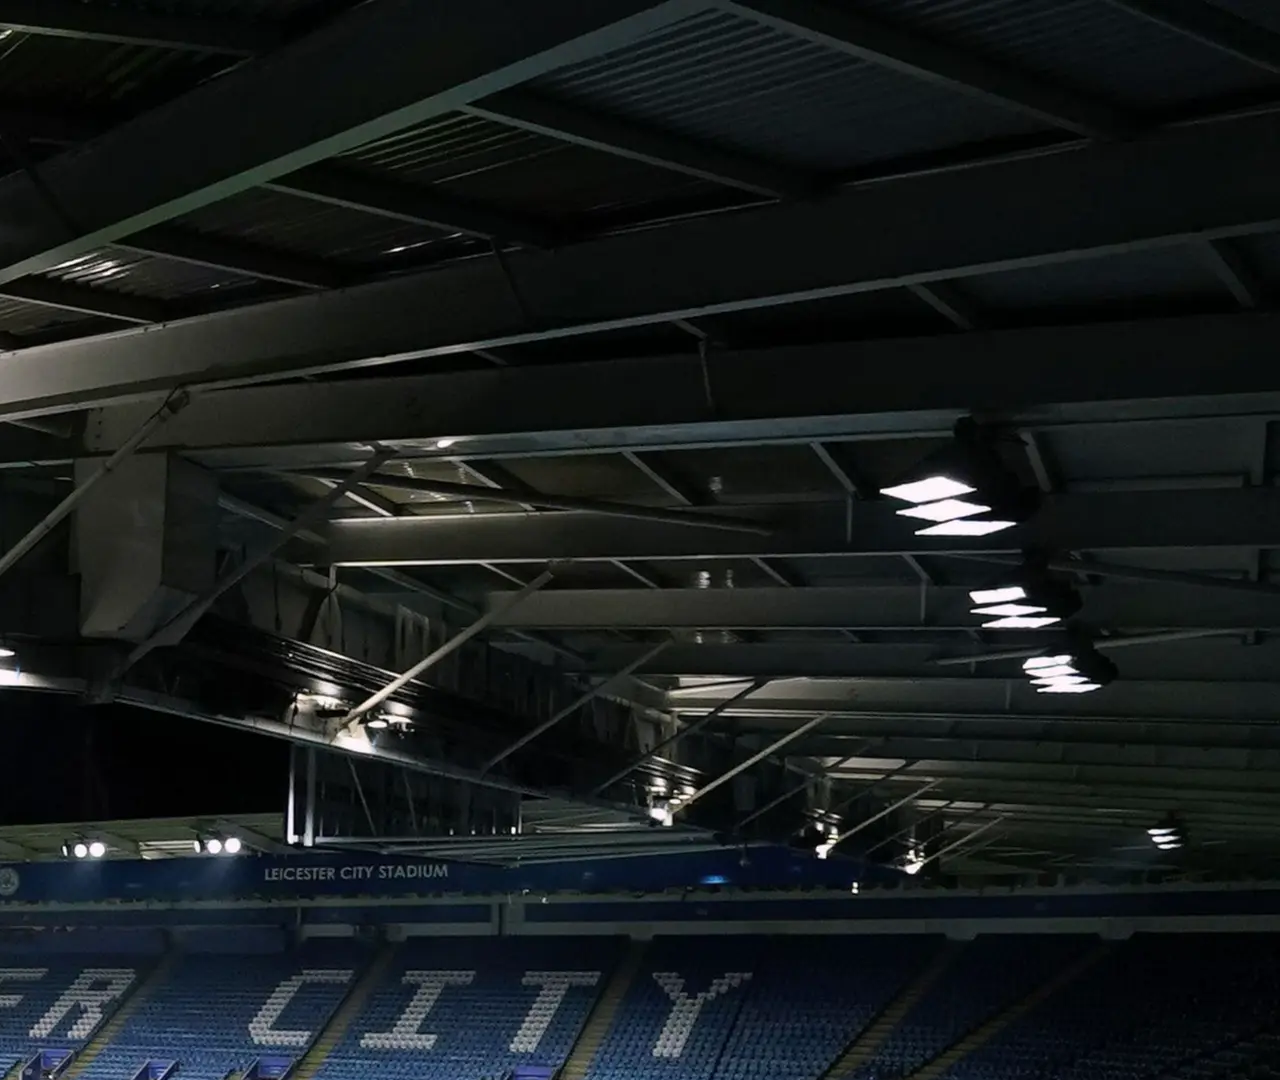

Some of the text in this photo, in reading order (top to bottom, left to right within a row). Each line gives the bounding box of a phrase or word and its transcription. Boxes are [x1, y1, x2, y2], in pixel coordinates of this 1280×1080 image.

[264, 864, 448, 881] LEICESTER CITY STADIUM
[248, 969, 753, 1058] CITY
